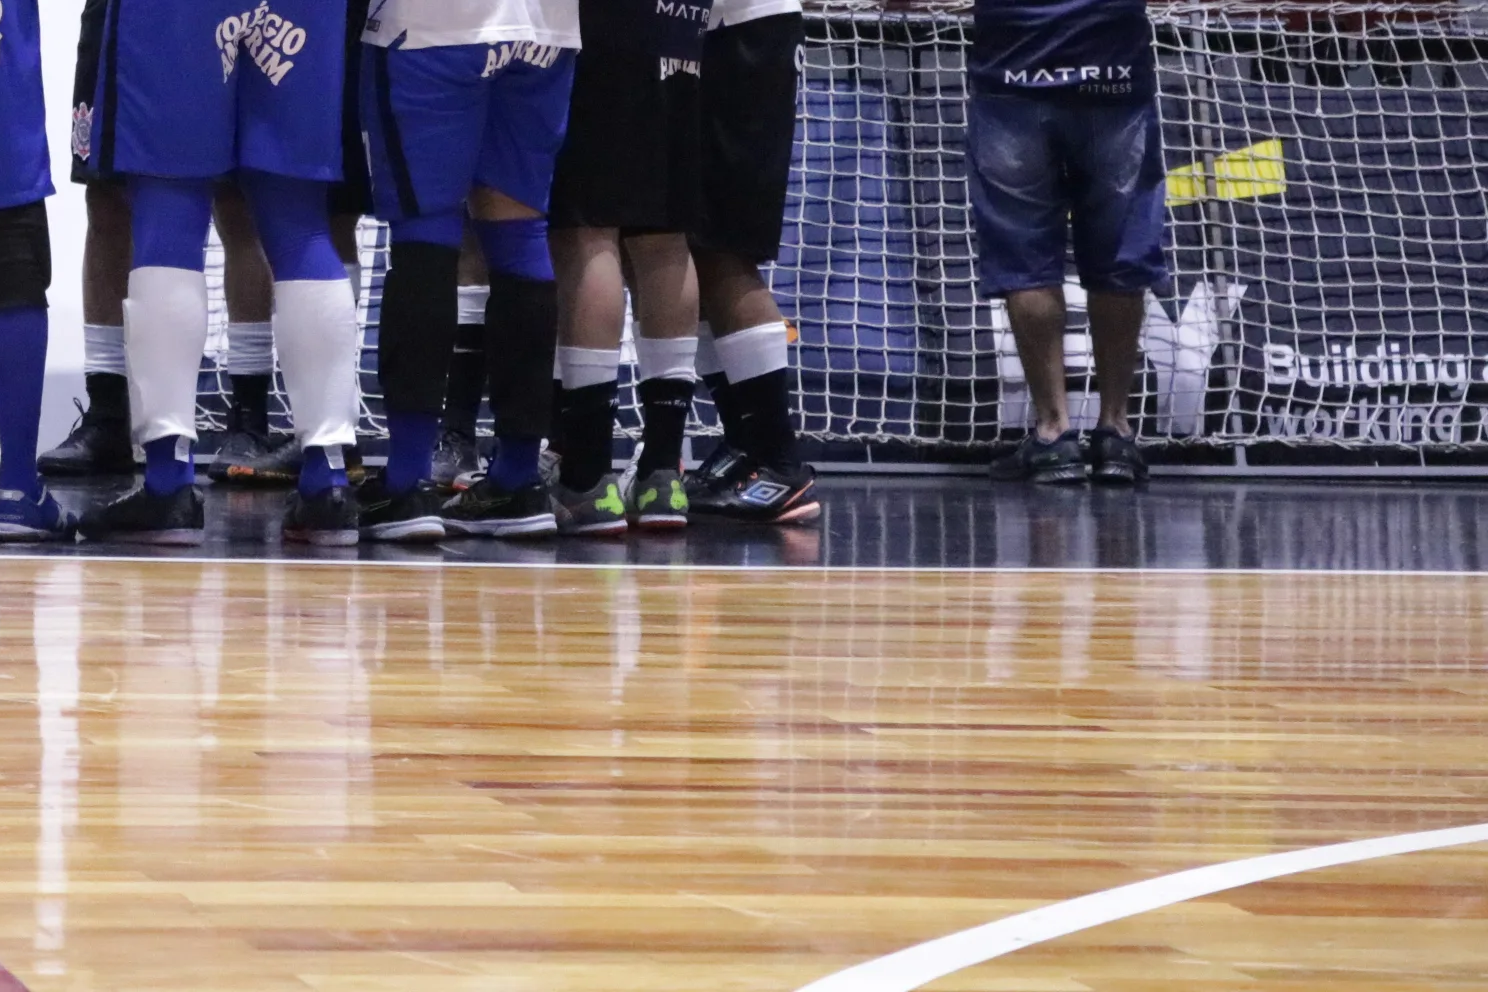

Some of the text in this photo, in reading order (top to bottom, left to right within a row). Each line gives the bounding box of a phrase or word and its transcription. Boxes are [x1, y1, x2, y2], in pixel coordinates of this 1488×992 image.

[1003, 65, 1133, 84] MATRIX
[1078, 82, 1133, 95] FITNESS
[1263, 343, 1466, 397] Building
[1265, 397, 1462, 442] working
